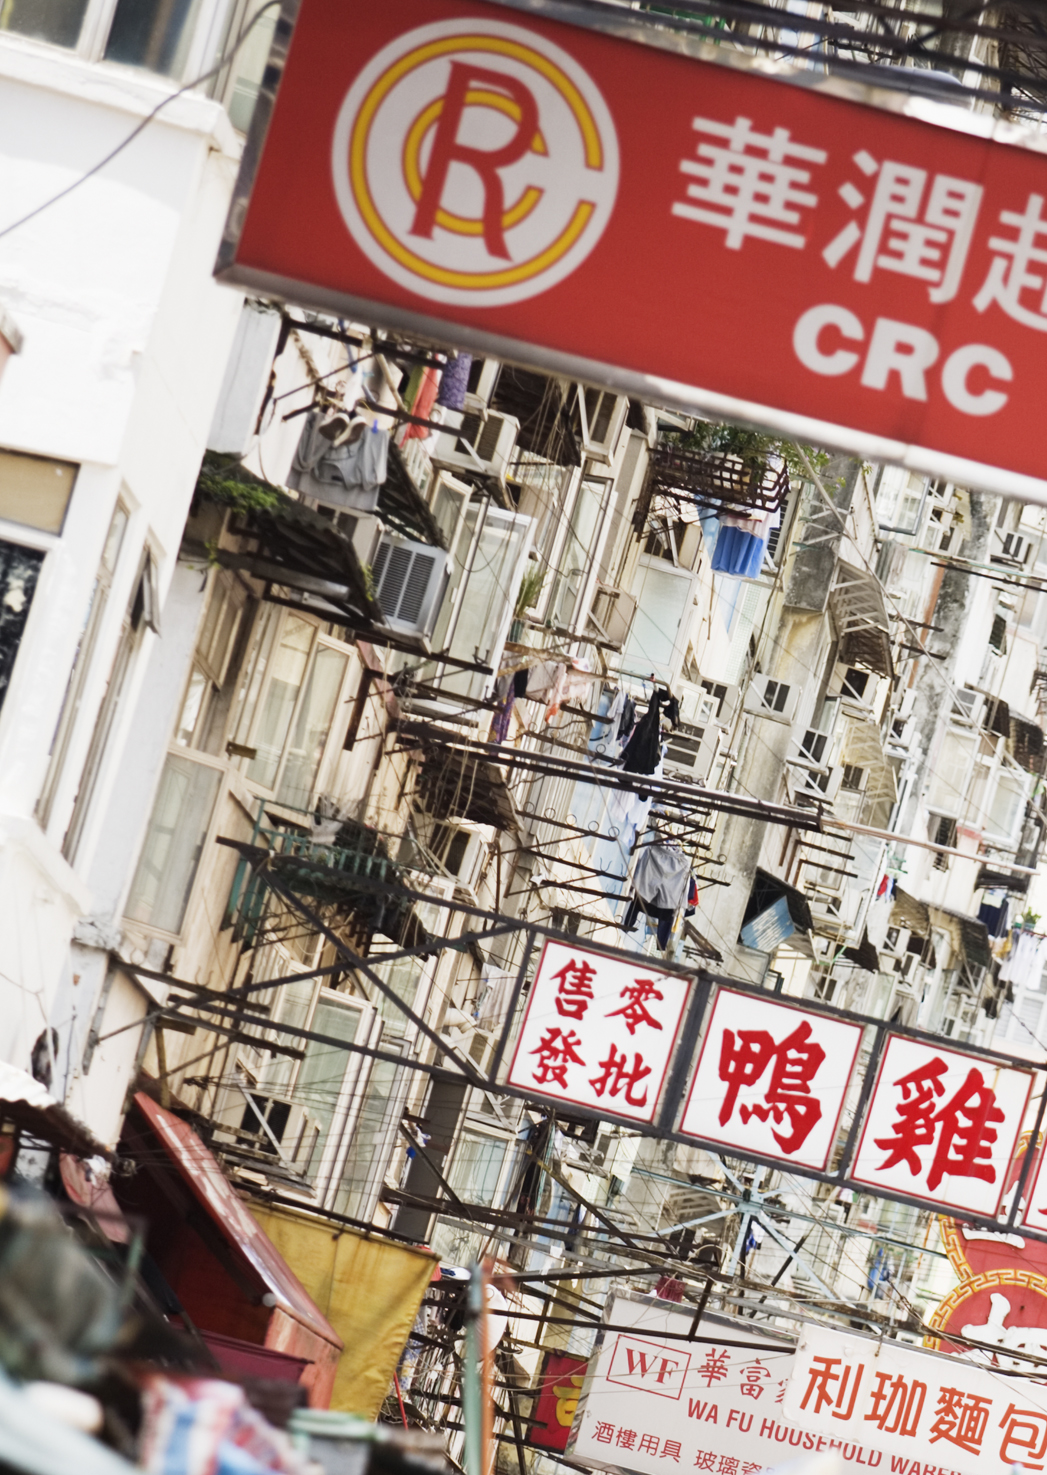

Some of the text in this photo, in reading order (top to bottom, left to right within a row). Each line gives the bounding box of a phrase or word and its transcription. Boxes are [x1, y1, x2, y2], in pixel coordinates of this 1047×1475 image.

[792, 303, 1014, 417] CRC
[625, 1347, 679, 1385] WF
[687, 1397, 719, 1425] WA
[725, 1408, 754, 1433] FU
